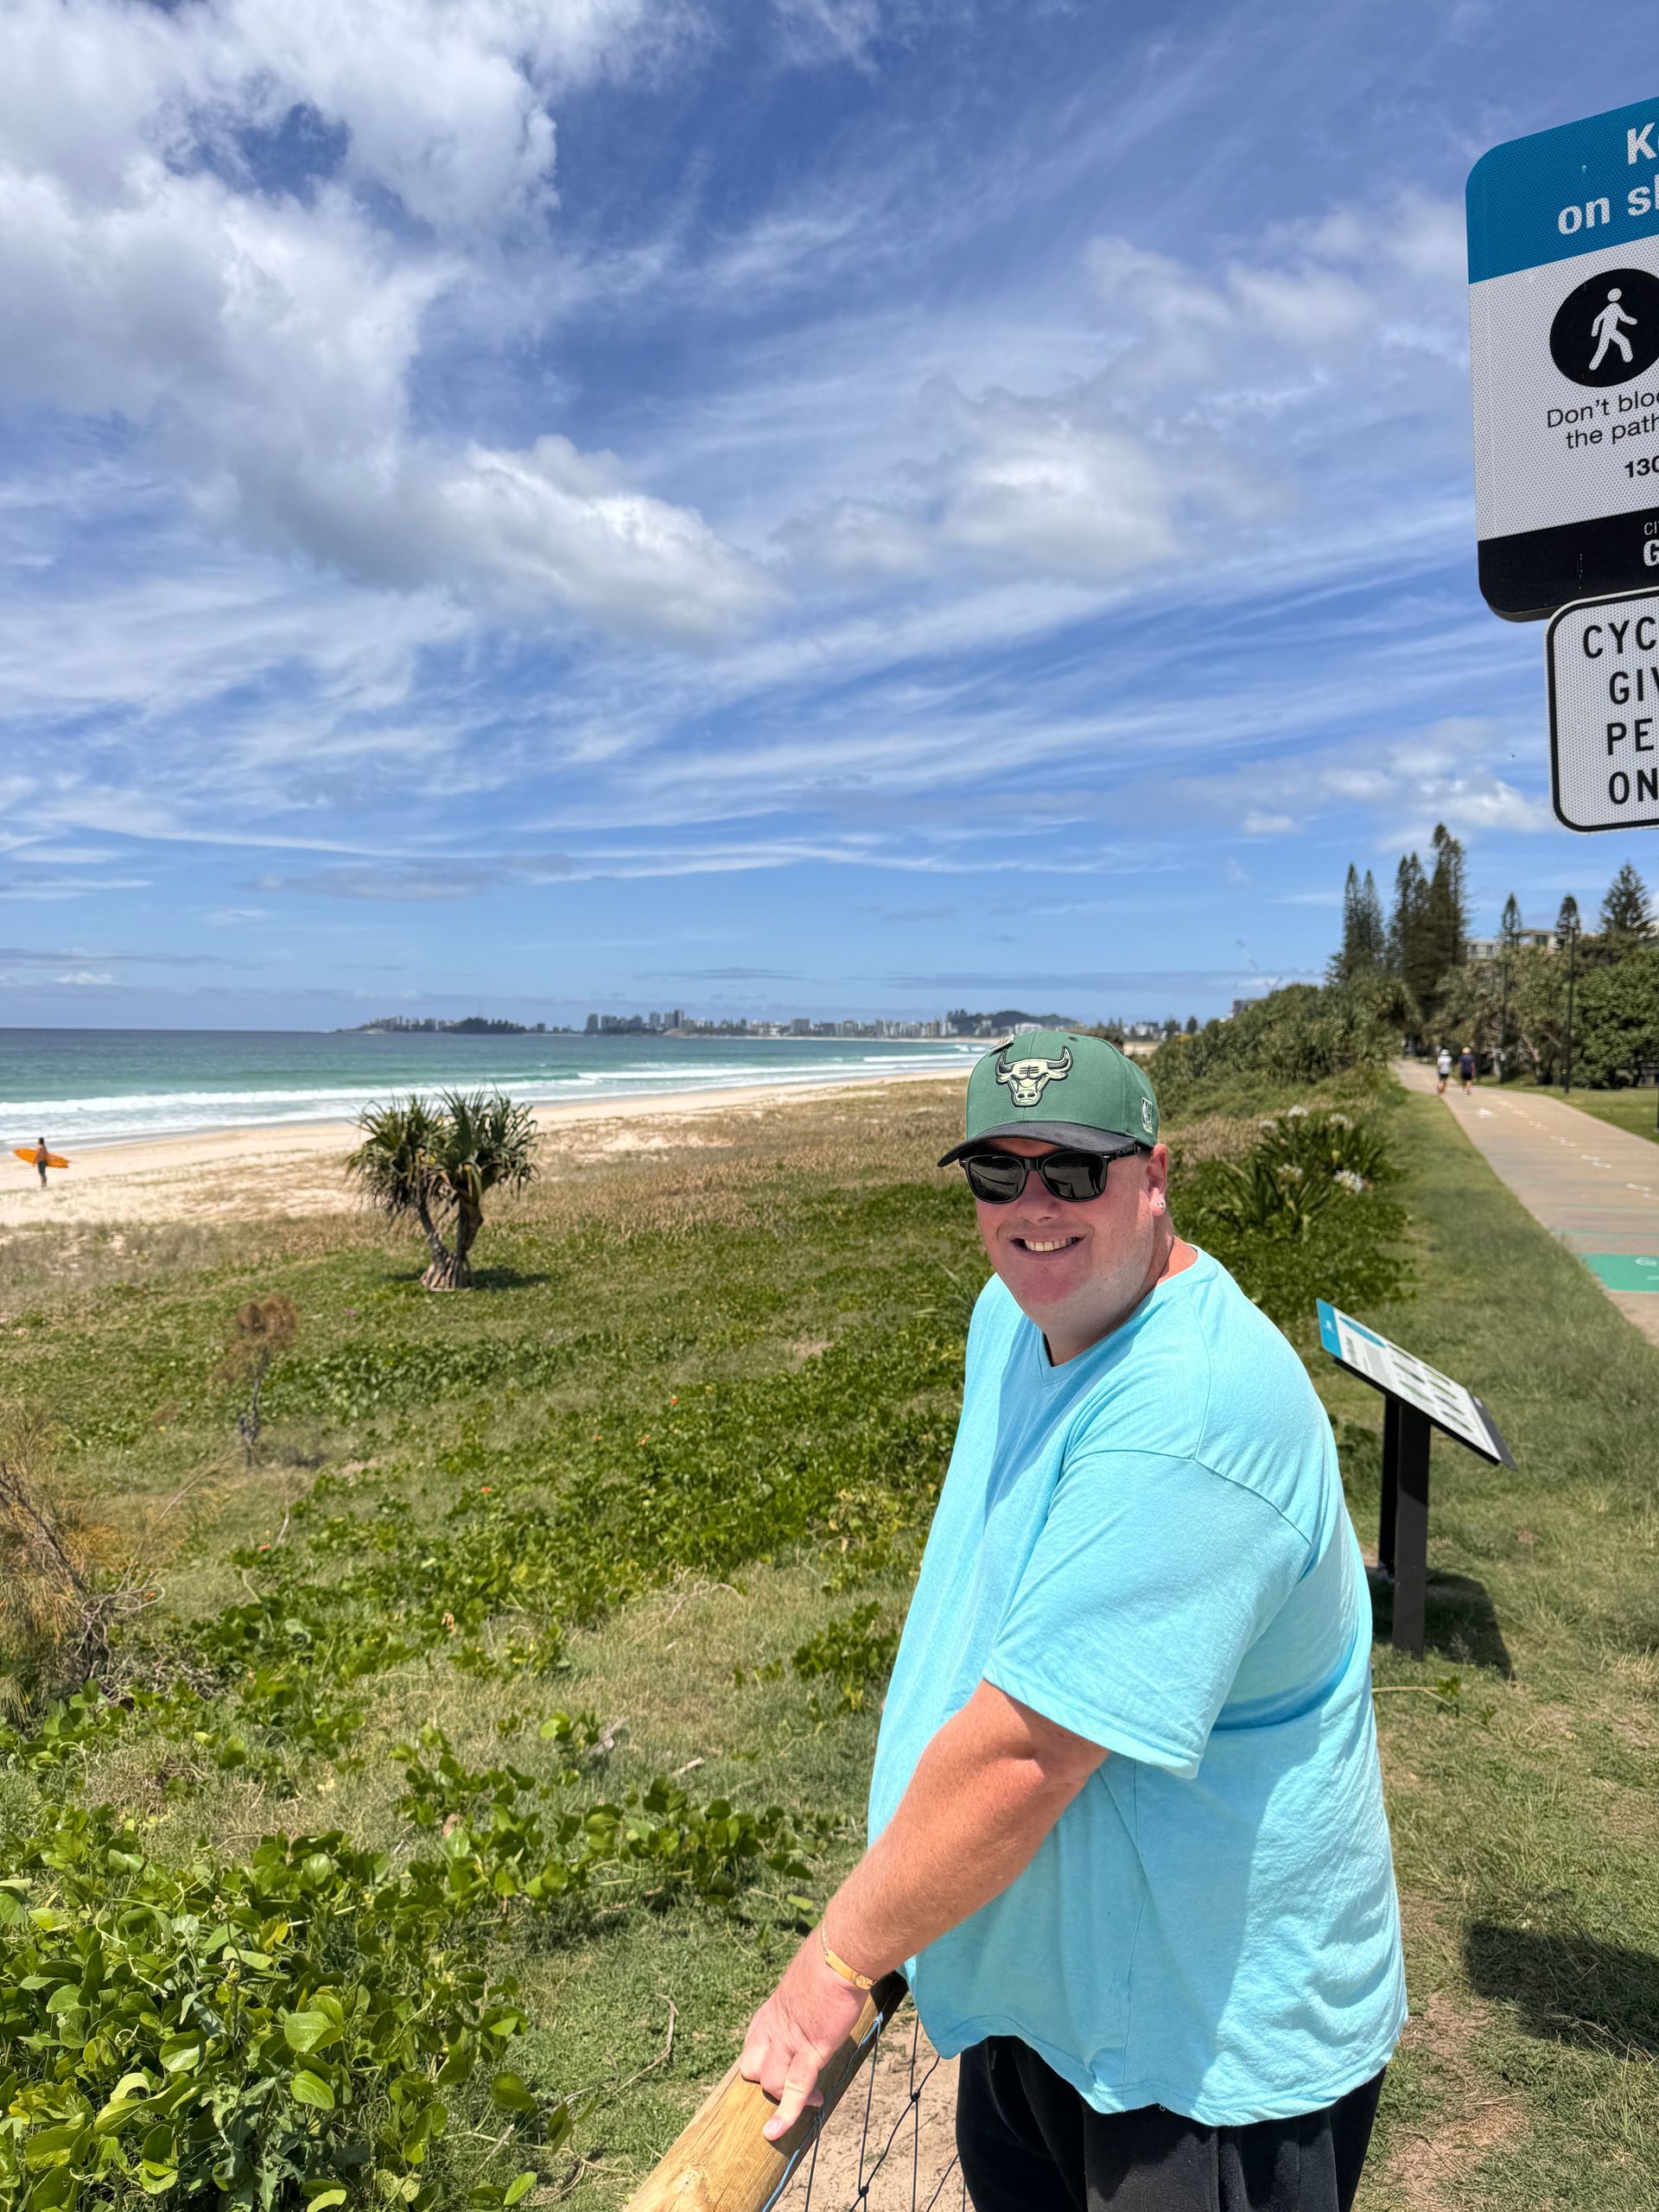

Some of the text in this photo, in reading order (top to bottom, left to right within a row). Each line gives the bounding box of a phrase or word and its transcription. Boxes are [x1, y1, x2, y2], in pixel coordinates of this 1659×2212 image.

[1626, 122, 1659, 165] K
[1558, 197, 1610, 235] on
[1548, 391, 1659, 428] Don't blo
[1566, 429, 1602, 448] the
[1643, 520, 1659, 535] CI
[1583, 616, 1657, 658] CYC
[1607, 718, 1655, 755] PE
[1609, 768, 1658, 804] ON
